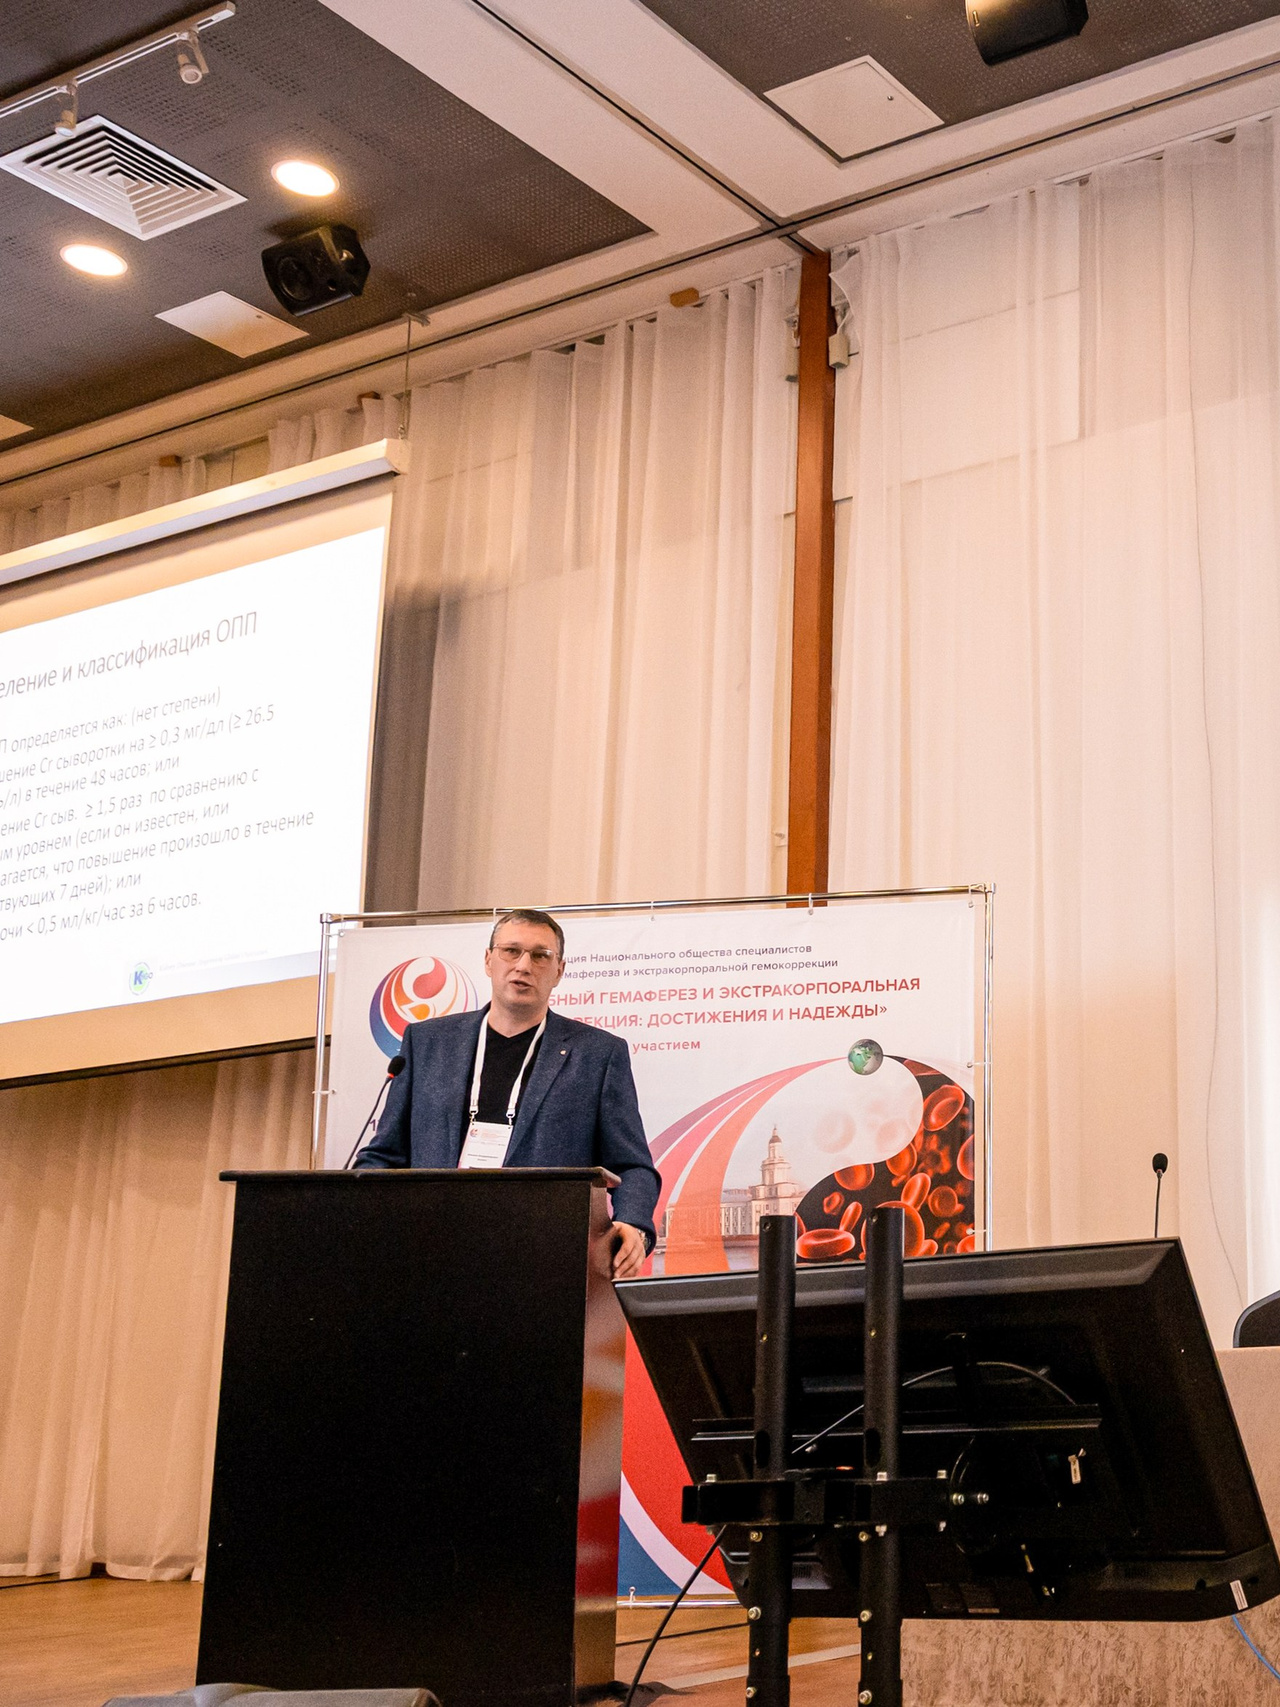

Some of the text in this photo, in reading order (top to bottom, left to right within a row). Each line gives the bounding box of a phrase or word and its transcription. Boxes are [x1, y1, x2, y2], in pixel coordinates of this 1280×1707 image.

[61, 664, 73, 684] и
[77, 628, 211, 680] классификация
[216, 610, 258, 644] ОПП
[10, 720, 99, 753] определяется
[101, 713, 128, 731] как:
[131, 705, 159, 727] (нет
[161, 685, 221, 717] степени)
[55, 742, 126, 771] сыворотки
[129, 737, 145, 753] на
[159, 725, 181, 747] 0,3
[183, 717, 225, 740] мг/дл
[245, 703, 275, 727] 26.5
[24, 788, 33, 802] в
[35, 776, 88, 800] течение
[89, 768, 107, 787] 48
[109, 762, 151, 782] часов;
[154, 755, 180, 773] или
[50, 808, 78, 826] сыв.
[97, 796, 117, 817] 1,5
[119, 793, 143, 815] раз
[149, 788, 167, 804] по
[169, 771, 248, 803] сравнению
[251, 768, 260, 783] с
[16, 834, 72, 862] уровнем
[75, 826, 111, 849] (если
[113, 822, 131, 838] он
[134, 809, 199, 834] известен,
[202, 801, 230, 819] или
[52, 859, 75, 876] что
[77, 843, 157, 871] повышение
[159, 826, 240, 858] произошло
[243, 823, 252, 839] в
[255, 811, 315, 836] течение
[59, 883, 68, 900] 7
[68, 873, 113, 902] дней);
[115, 873, 142, 889] или
[37, 914, 57, 936] 0,5
[59, 903, 127, 931] мл/кг/час
[128, 902, 144, 919] за
[147, 896, 156, 915] 6
[158, 892, 202, 912] часов.
[590, 951, 676, 963] Национального
[678, 948, 732, 959] общества
[735, 945, 812, 956] специалистов
[623, 969, 630, 977] и
[633, 962, 748, 977] экстракорпоральной
[751, 959, 839, 973] гемокоррекции
[599, 987, 698, 1005] ГЕМАФЕРЕЗ
[702, 987, 714, 1000] И
[719, 977, 921, 999] ЭКСТРАКОРПОРАЛЬНАЯ
[646, 1009, 768, 1029] ДОСТИЖЕНИЯ
[772, 1008, 784, 1021] И
[789, 1003, 888, 1022] НАДЕЖДЫ»
[632, 1040, 701, 1055] участием
